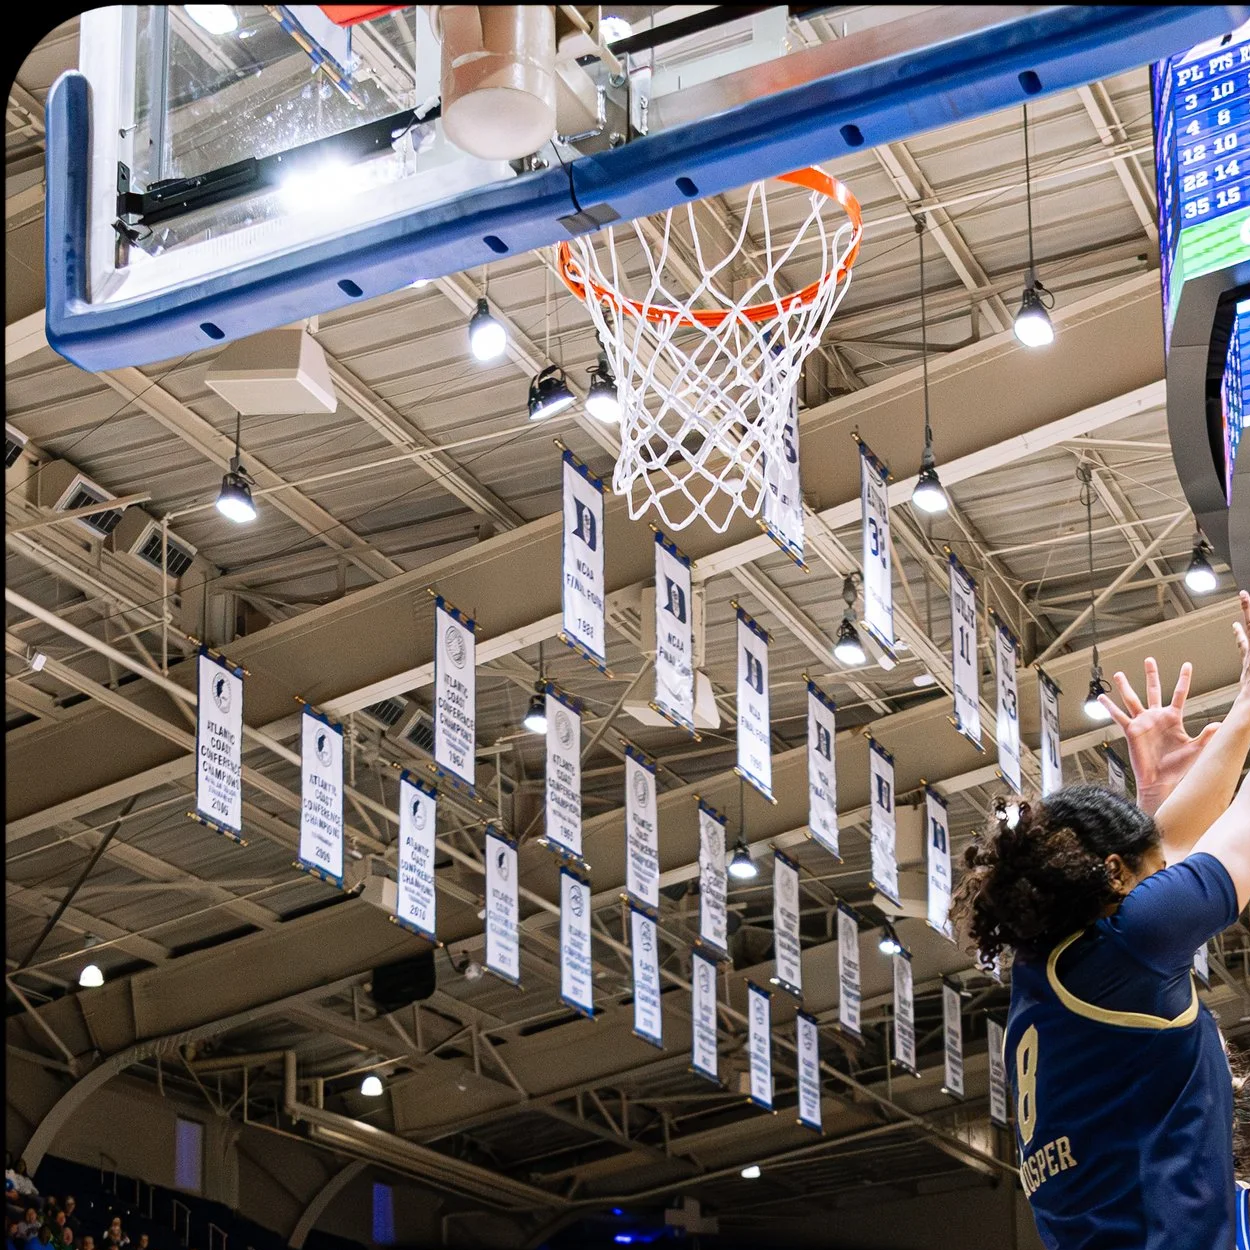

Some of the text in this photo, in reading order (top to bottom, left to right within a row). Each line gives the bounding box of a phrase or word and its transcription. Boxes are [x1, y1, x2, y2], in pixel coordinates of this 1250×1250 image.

[1177, 65, 1204, 87] PL
[1209, 52, 1234, 75] PTS
[1185, 93, 1198, 110] 3
[1211, 80, 1235, 101] 10
[1186, 120, 1200, 136] 4
[1217, 108, 1230, 126] 8
[1183, 144, 1206, 165] 12
[1213, 132, 1237, 154] 10
[1184, 171, 1208, 192] 22
[1214, 160, 1240, 181] 14
[1185, 197, 1210, 219] 35
[1216, 186, 1240, 208] 15
[566, 573, 586, 597] FINAL
[207, 720, 235, 745] ATLANTIC
[211, 737, 231, 756] COAST
[201, 745, 241, 776] CONFERENCE
[203, 761, 240, 790] CHAMPIONS
[1016, 1023, 1038, 1146] 8
[1020, 1136, 1077, 1198] OSPER
